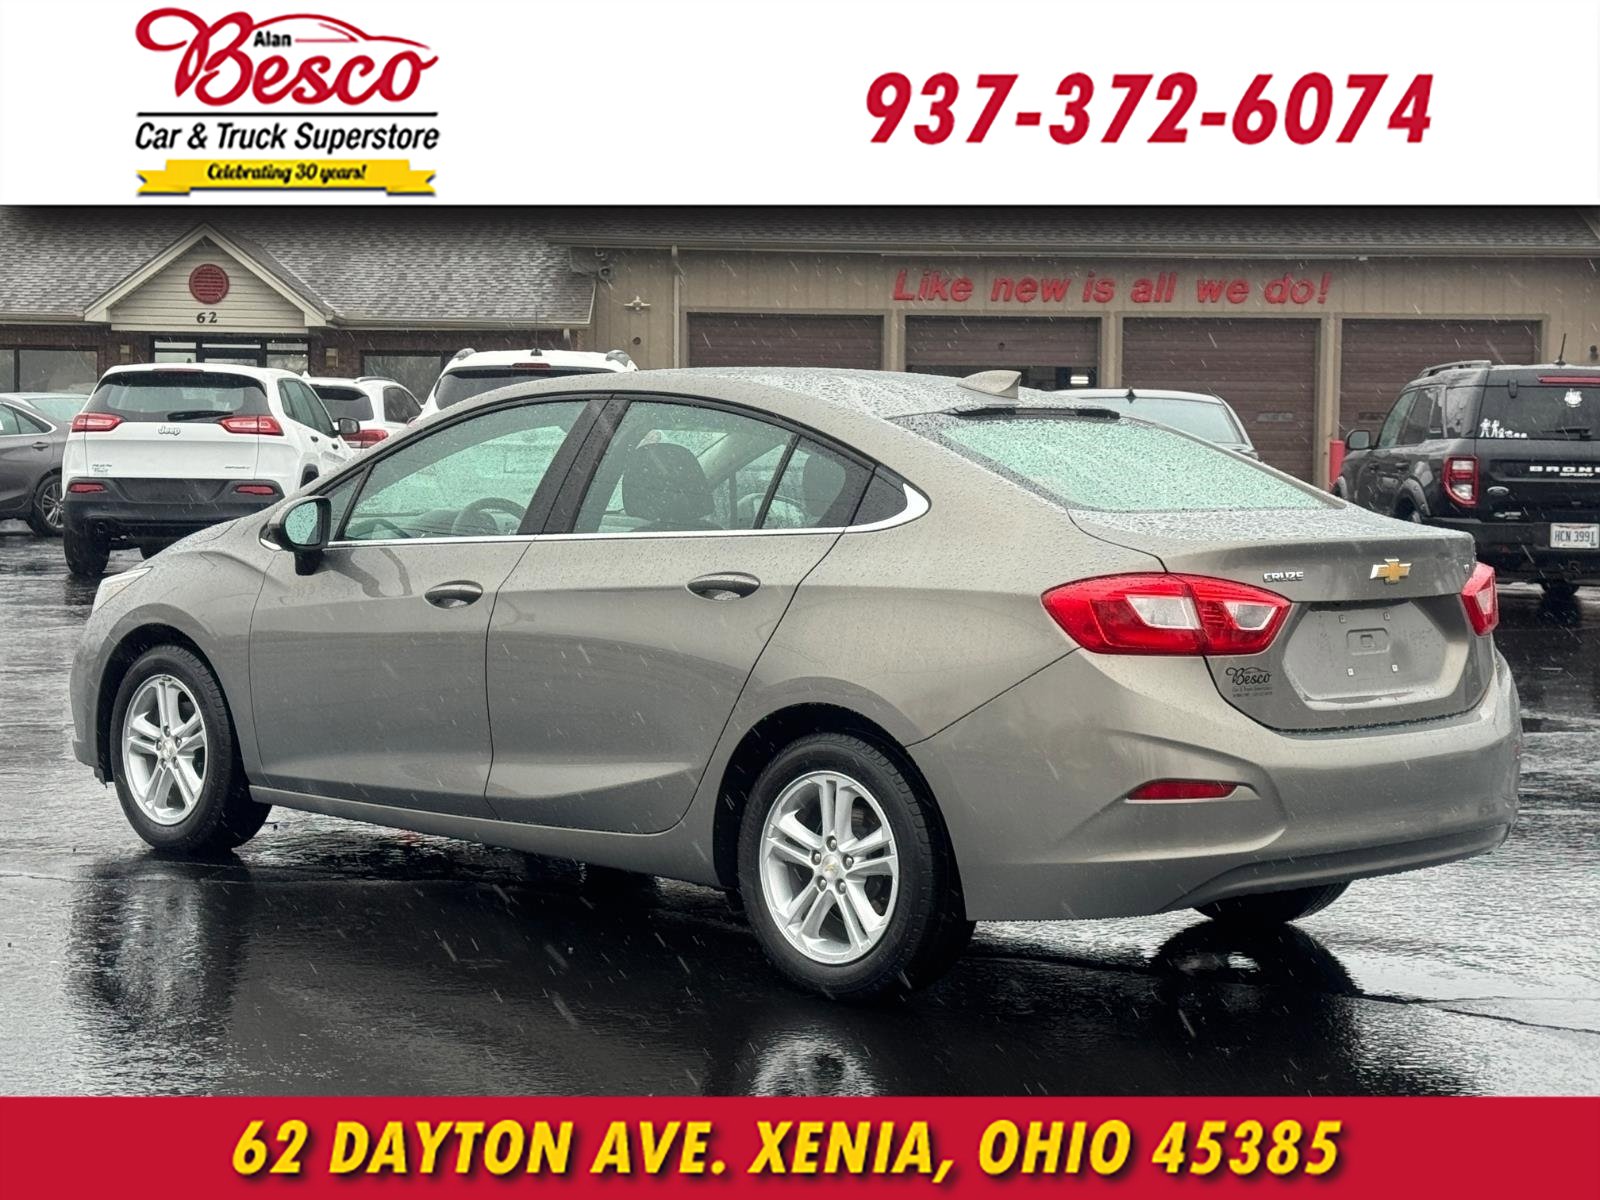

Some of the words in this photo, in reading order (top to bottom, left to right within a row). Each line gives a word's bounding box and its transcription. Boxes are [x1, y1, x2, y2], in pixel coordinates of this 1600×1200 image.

[892, 269, 974, 302] Like
[991, 273, 1071, 302] new
[1082, 271, 1116, 303] is
[1130, 271, 1177, 304] all
[1196, 278, 1250, 305] we
[1264, 271, 1331, 305] do!
[196, 311, 218, 324] 62
[157, 425, 181, 436] Jeep
[1554, 530, 1571, 542] HCN
[1574, 530, 1595, 543] 3991
[1263, 571, 1304, 583] CRUZE
[1225, 667, 1273, 685] Besco
